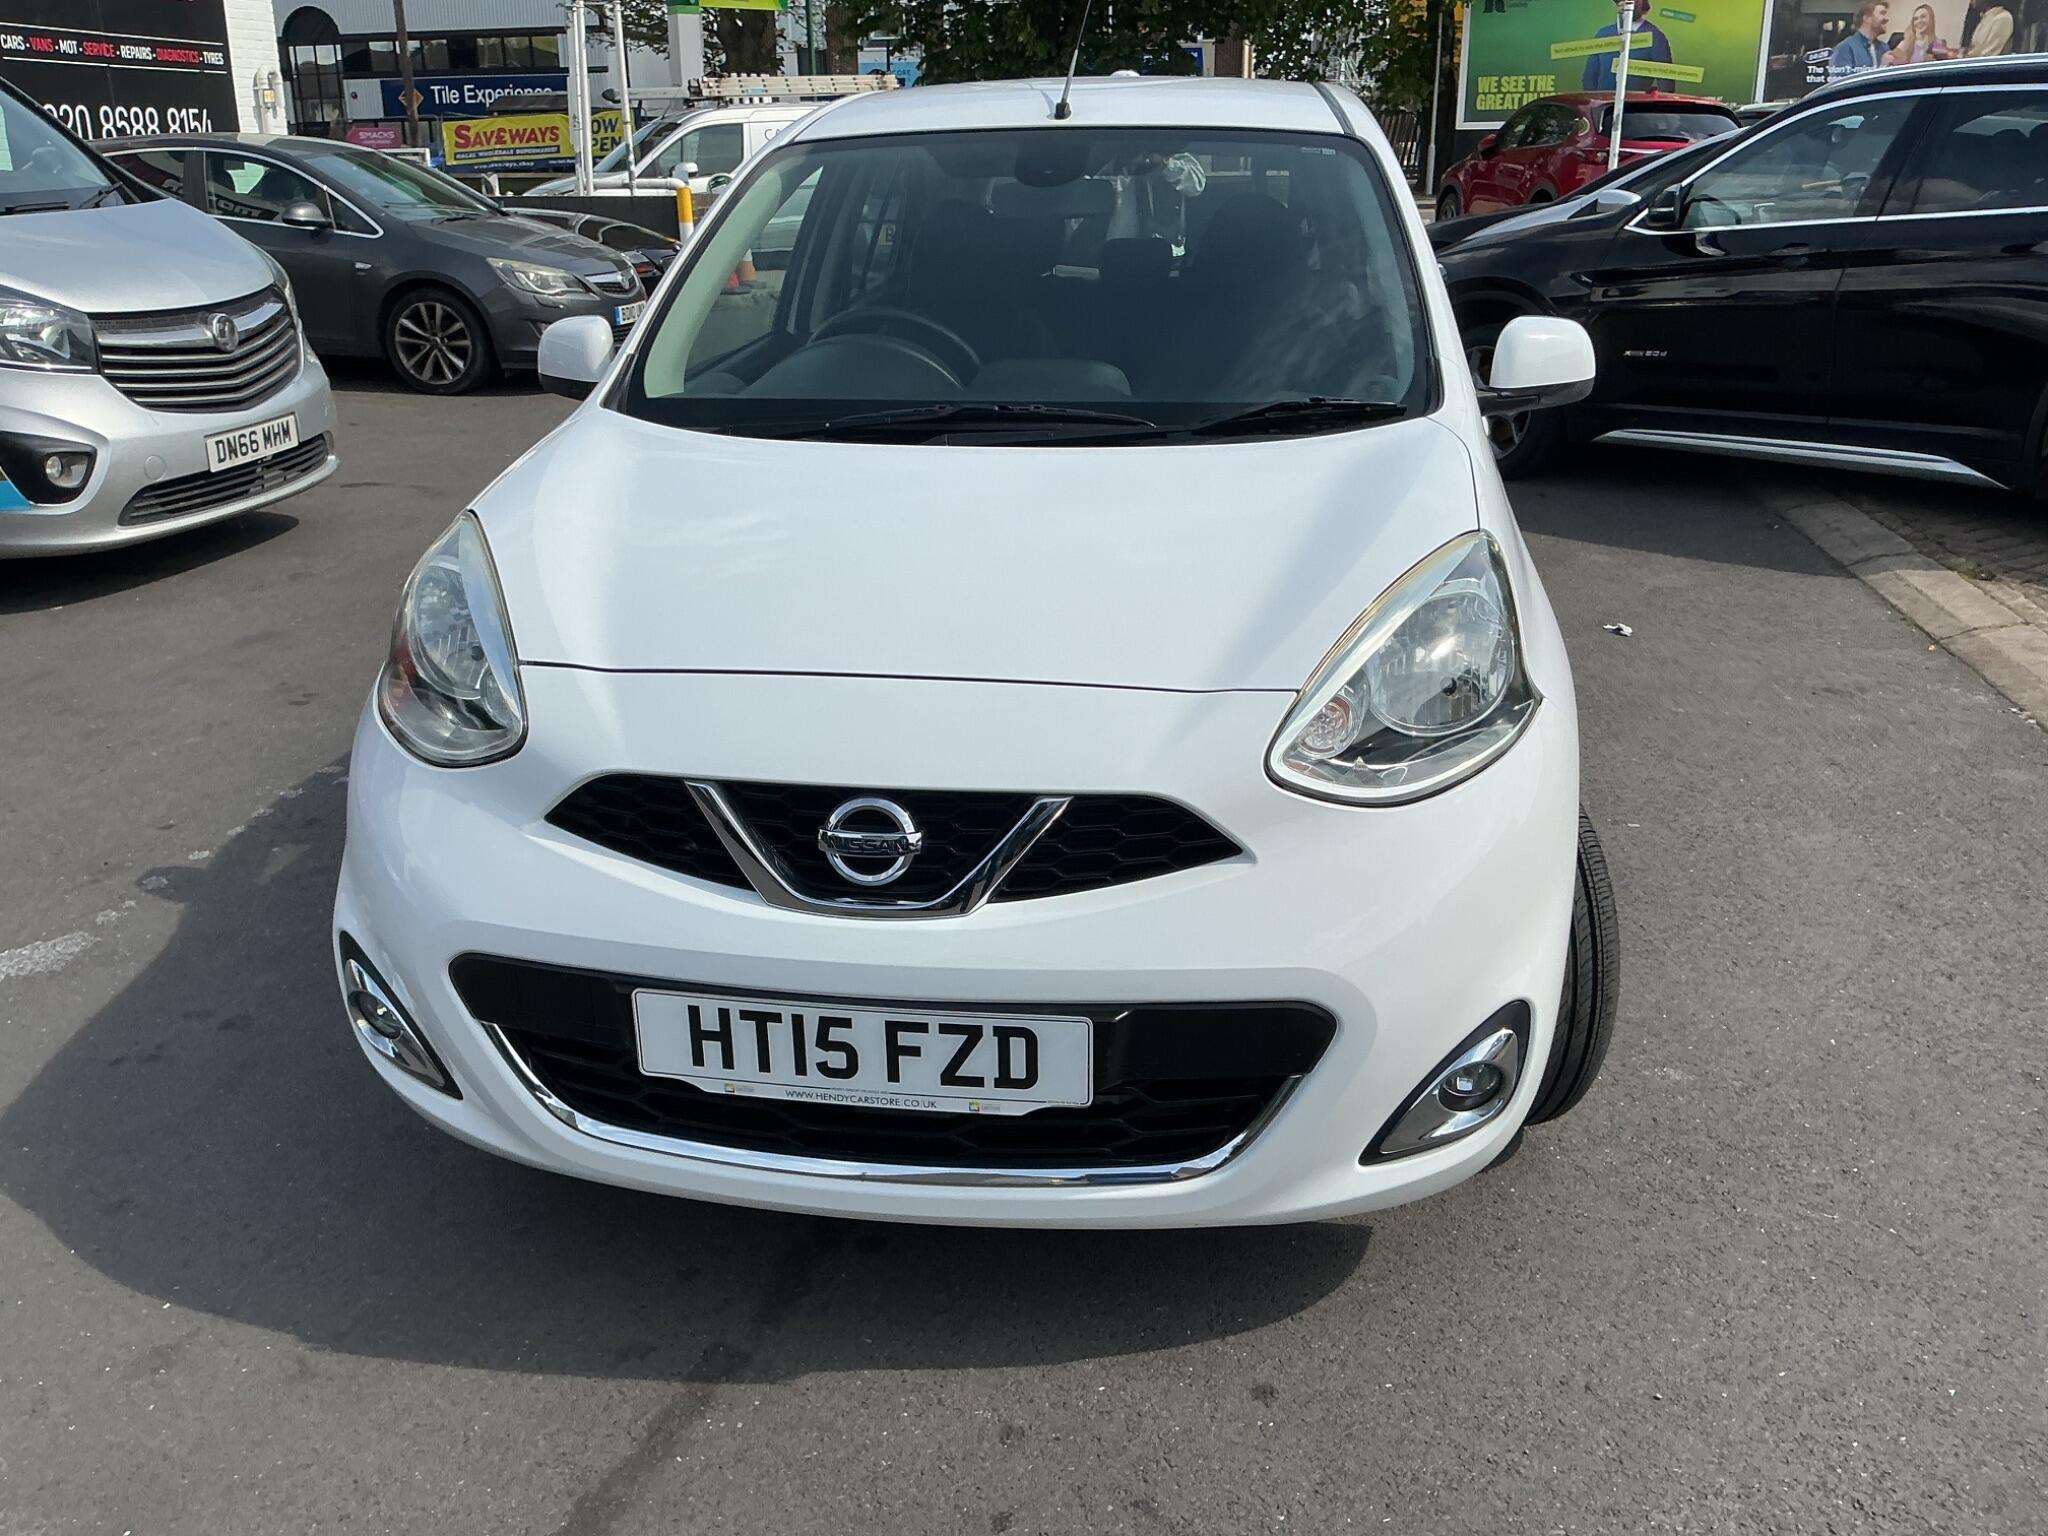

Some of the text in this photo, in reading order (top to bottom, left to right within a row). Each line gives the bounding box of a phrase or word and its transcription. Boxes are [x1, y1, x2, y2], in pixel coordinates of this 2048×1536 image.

[1, 34, 224, 65] CARS VANS MOT SERVICE REPAIRS DIAGNOSTICS TYRES
[1478, 75, 1556, 92] WE SEE THE
[430, 85, 460, 104] Tile
[1476, 93, 1521, 110] GREAT
[592, 118, 618, 134] OW
[592, 136, 621, 151] PEN
[215, 420, 292, 463] DN66 MHM
[830, 837, 904, 853] NISSAN
[688, 1004, 1038, 1089] HT15 FZD
